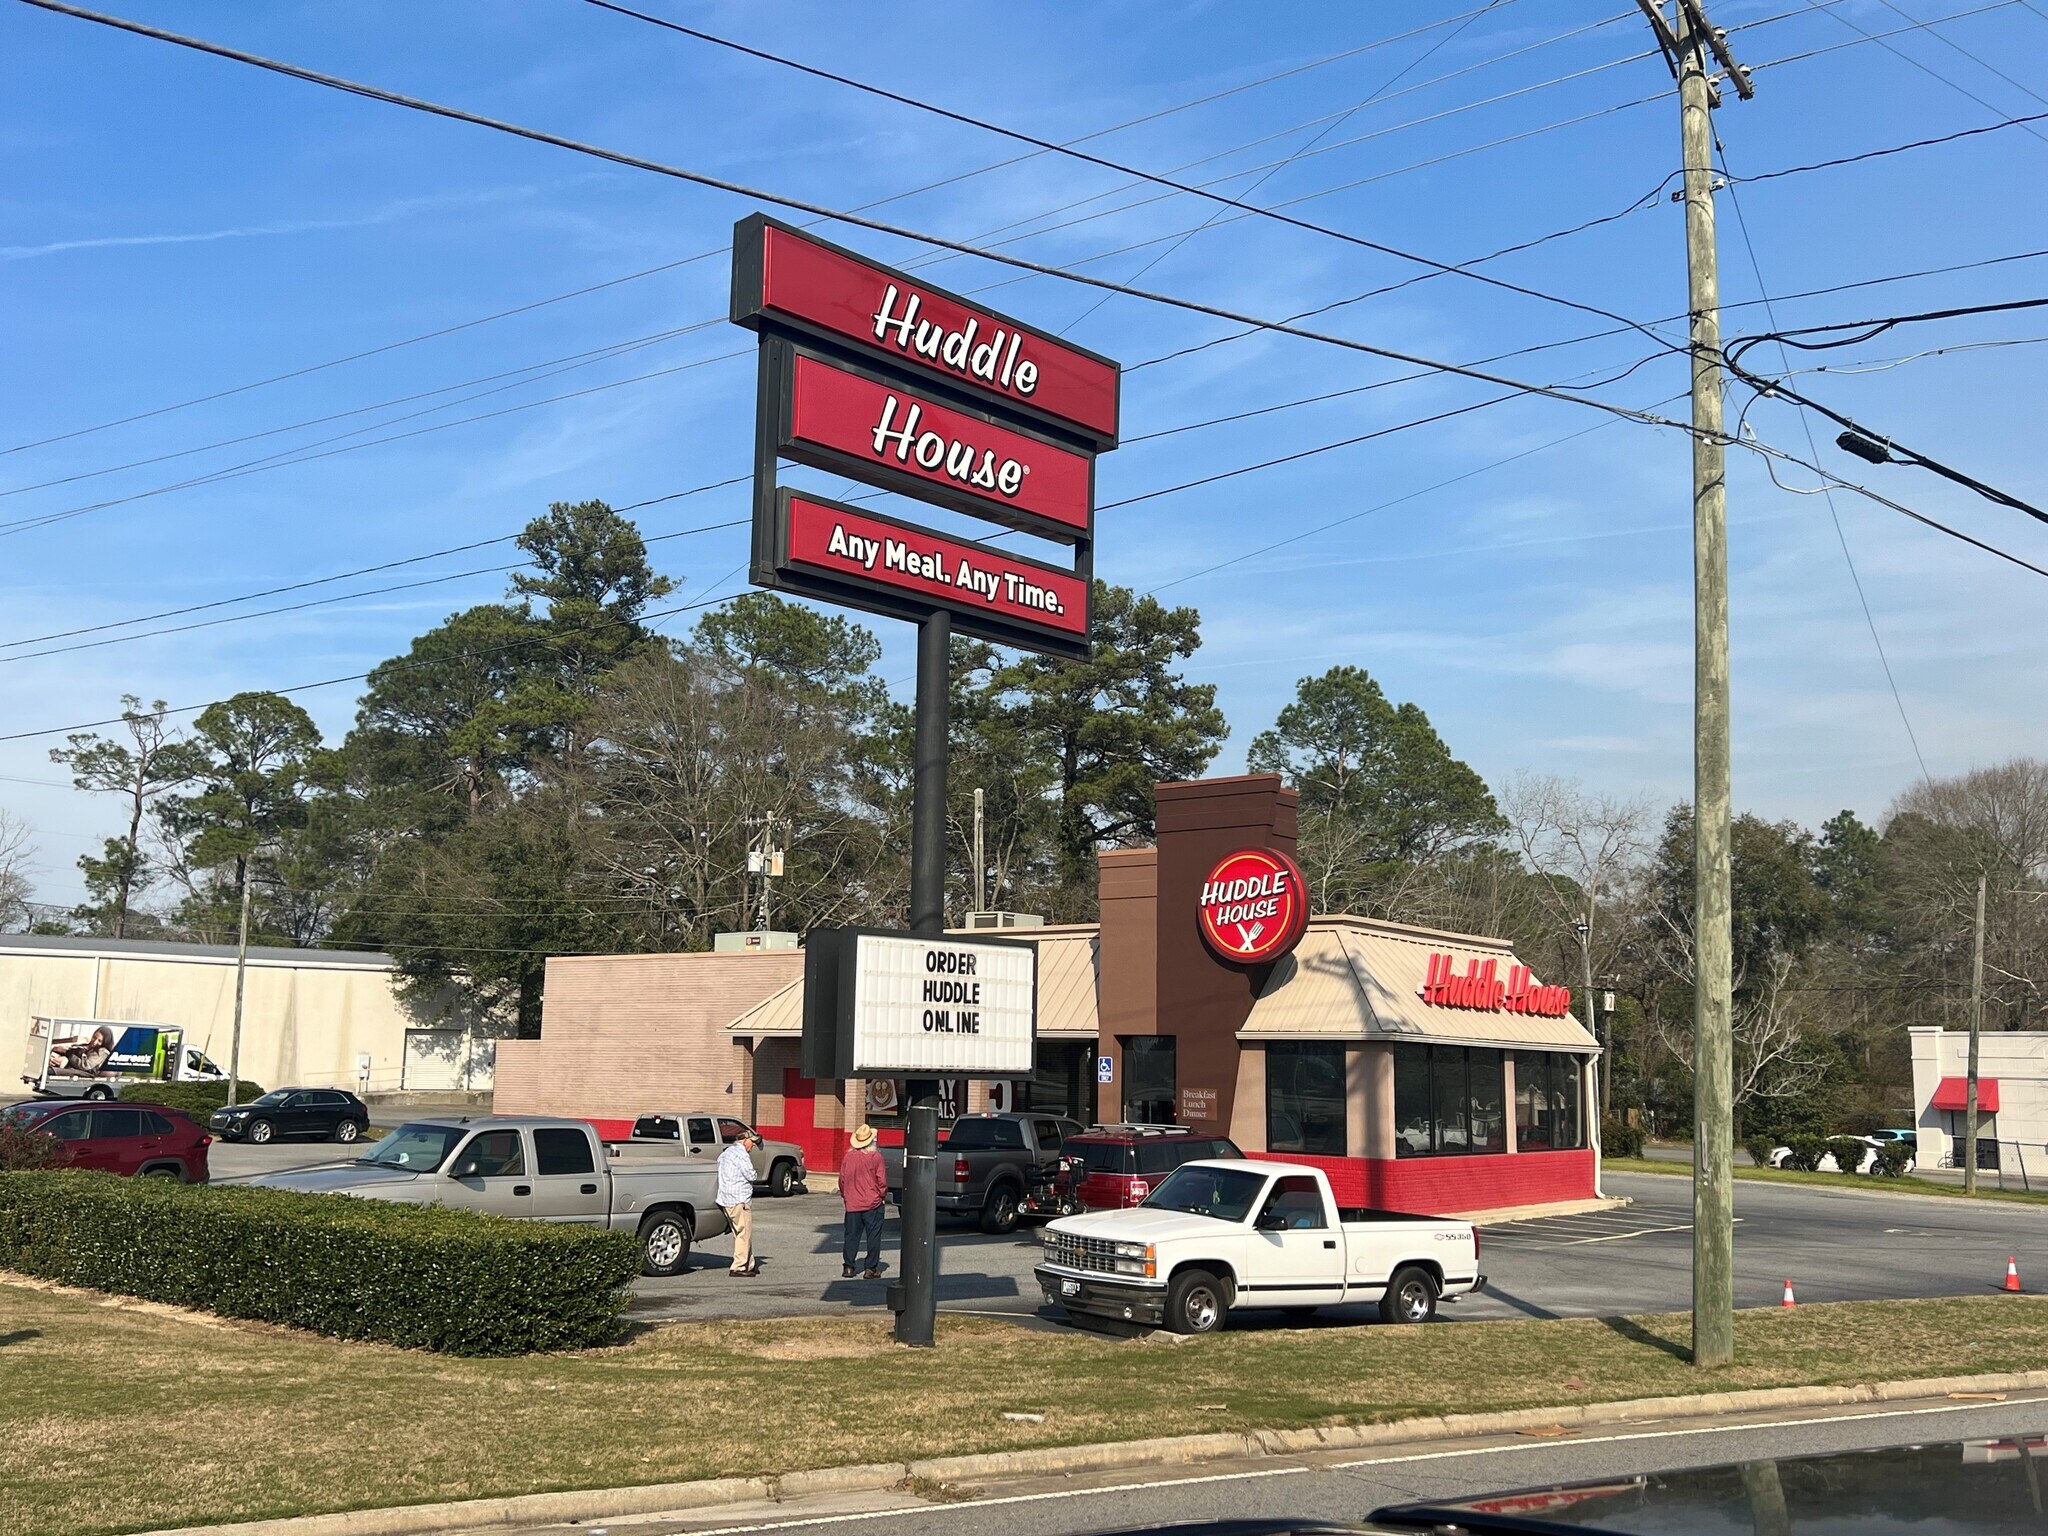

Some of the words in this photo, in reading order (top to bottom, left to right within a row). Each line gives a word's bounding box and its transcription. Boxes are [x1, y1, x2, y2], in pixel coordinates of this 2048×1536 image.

[873, 284, 1039, 394] Huddle
[827, 524, 880, 570] Any
[884, 538, 952, 584] Meal.
[955, 560, 1001, 602] Any
[1003, 571, 1064, 615] Time.
[1200, 870, 1289, 906] HUDDLE
[1216, 897, 1280, 926] HOUSE
[926, 950, 977, 975] ORDER
[923, 980, 980, 1005] HUDDLE
[1423, 953, 1506, 1009] Huddle
[1504, 965, 1571, 1015] House
[923, 1009, 980, 1034] ONLINE
[1183, 1089, 1216, 1099] Breakfast
[1183, 1099, 1206, 1109] Lunch
[1183, 1109, 1208, 1118] Dinner
